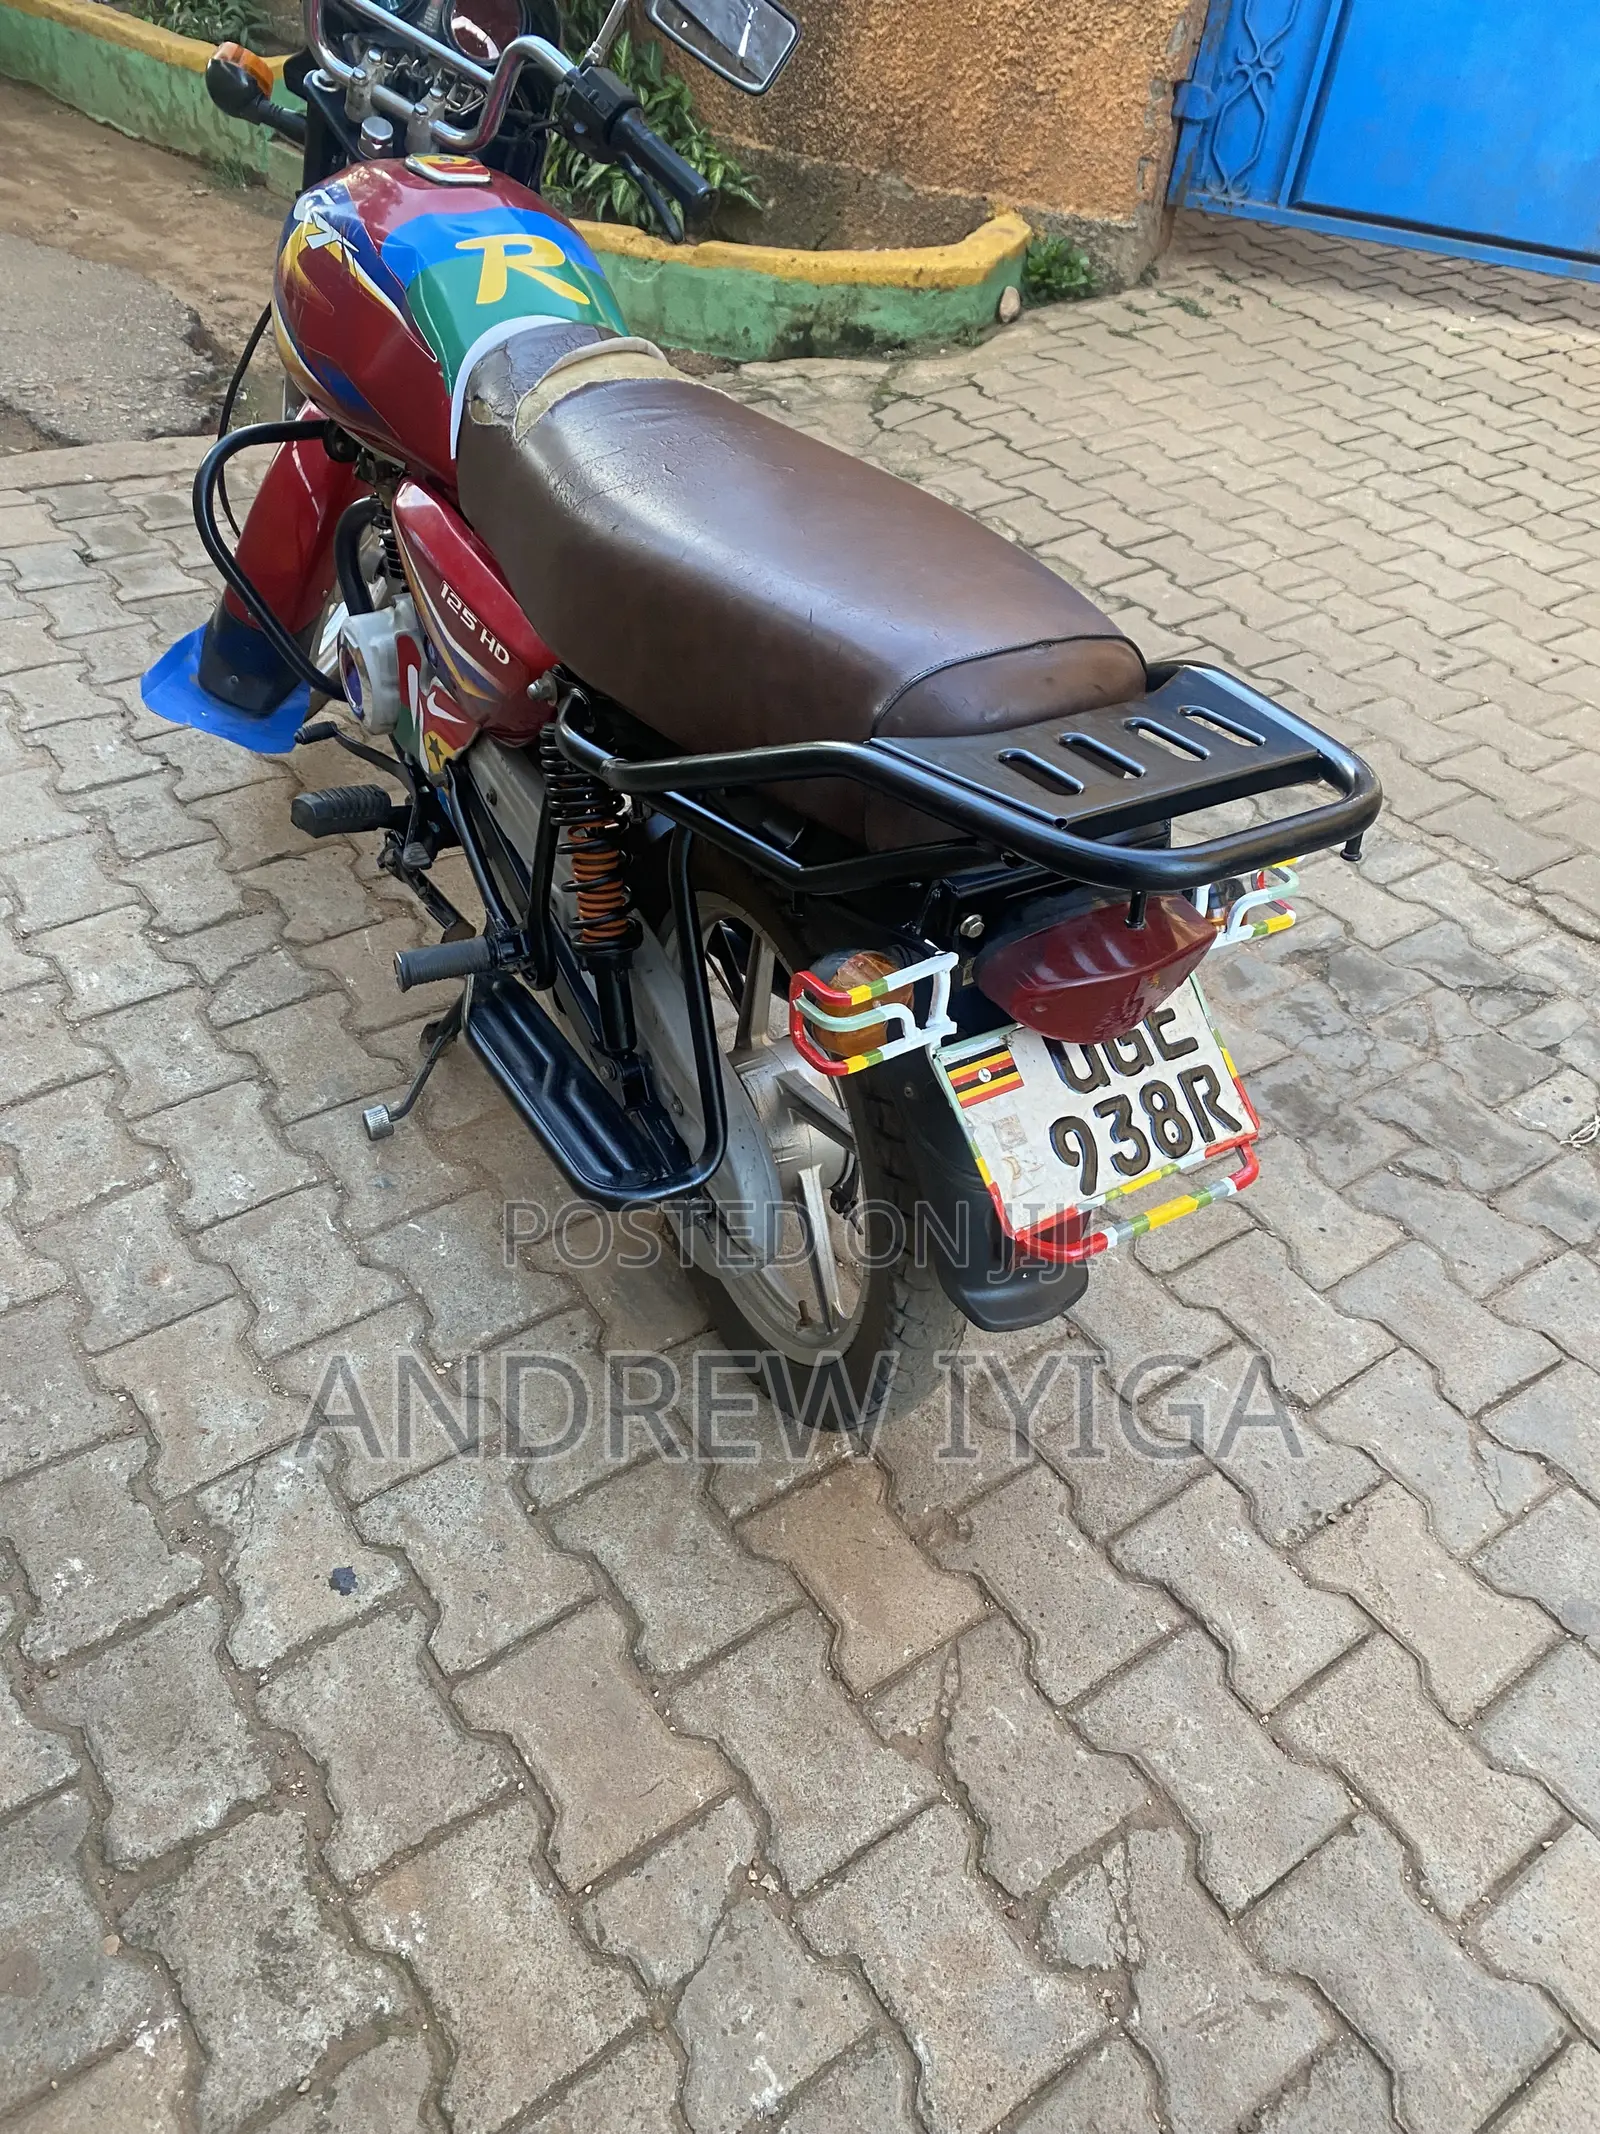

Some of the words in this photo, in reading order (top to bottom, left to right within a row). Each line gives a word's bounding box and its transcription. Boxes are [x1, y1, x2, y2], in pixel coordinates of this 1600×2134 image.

[440, 583, 478, 631] 125
[480, 628, 510, 665] HD
[1048, 1064, 1243, 1197] 938R
